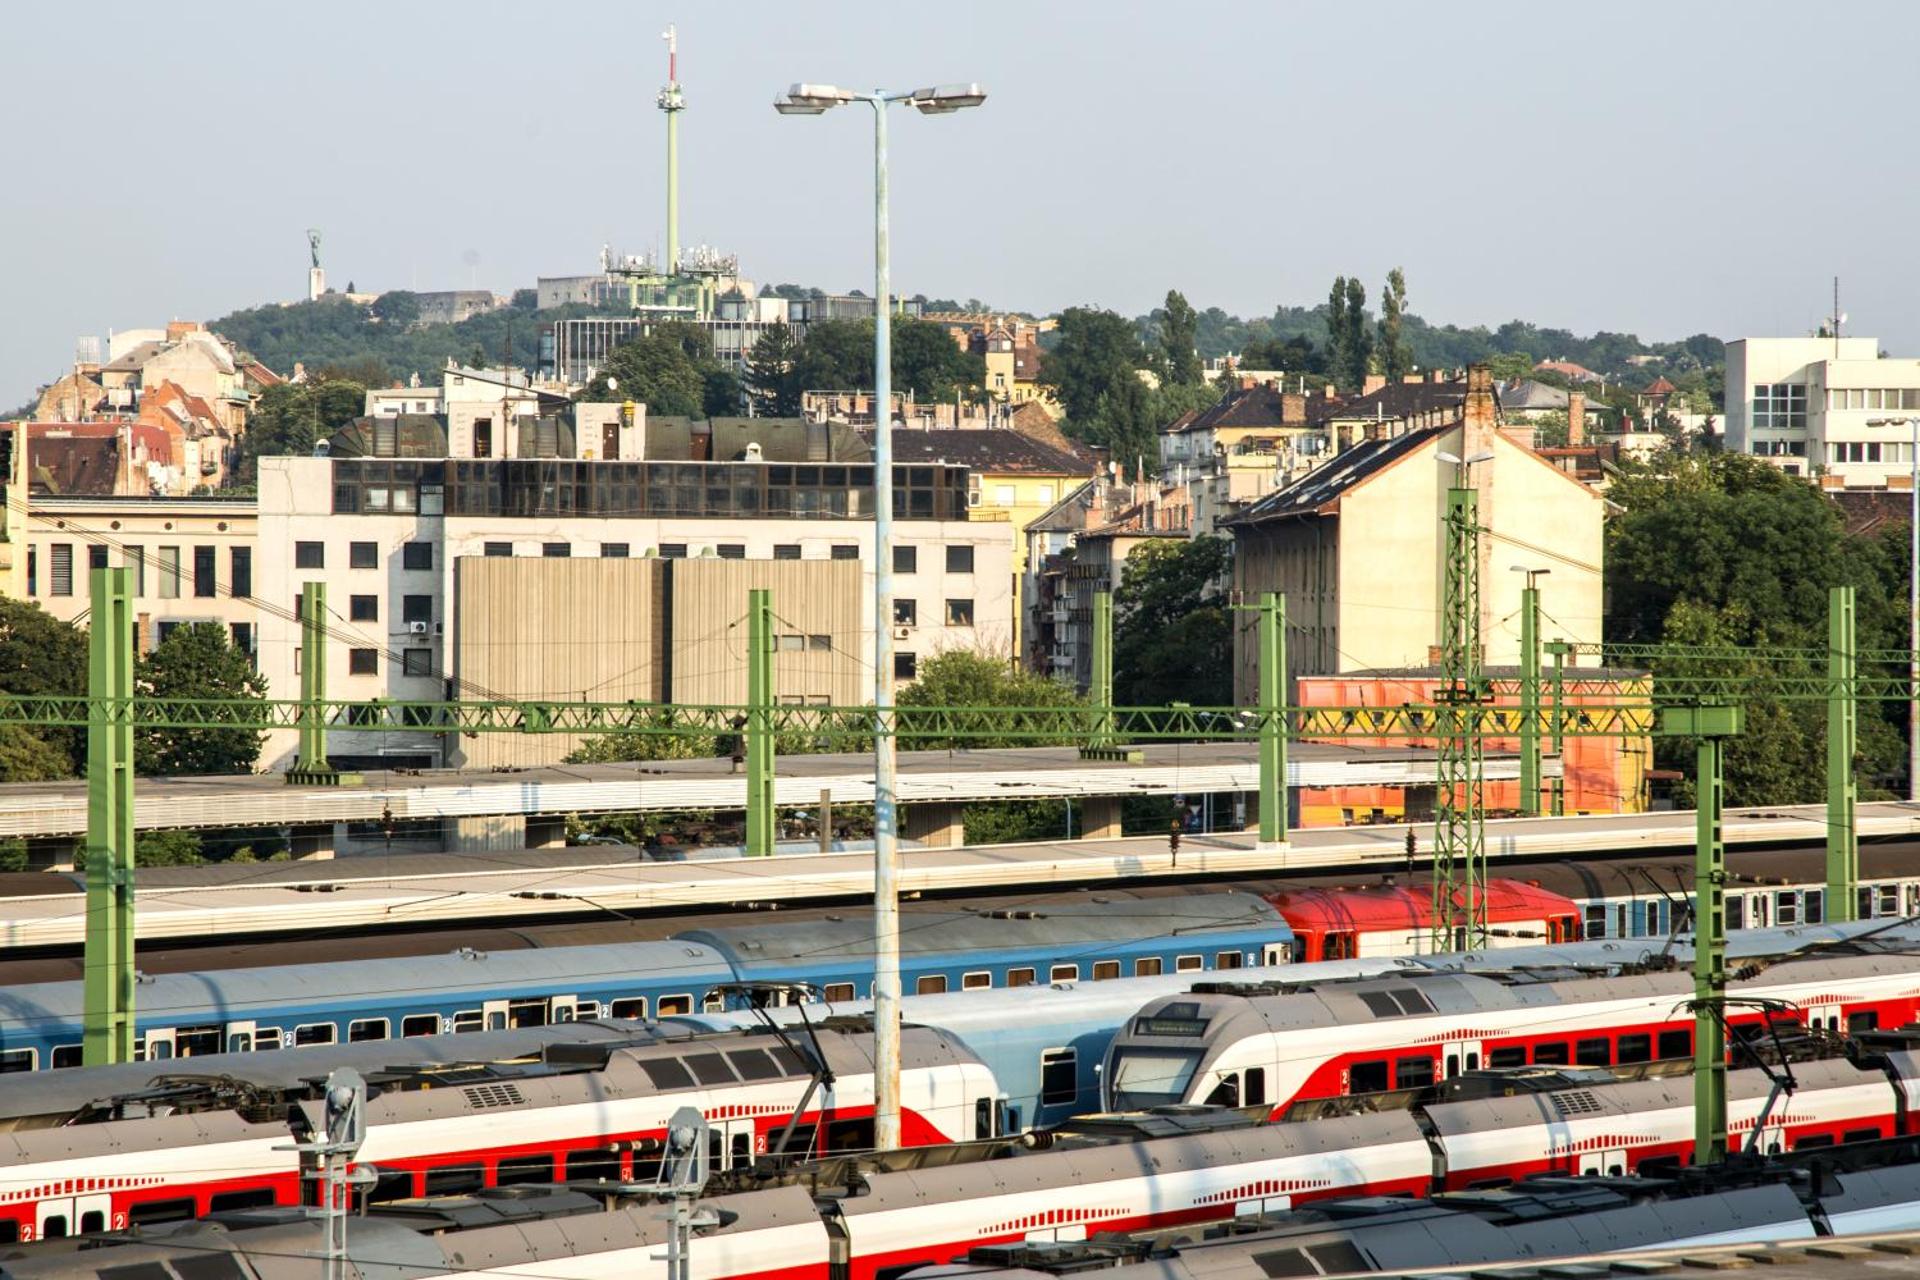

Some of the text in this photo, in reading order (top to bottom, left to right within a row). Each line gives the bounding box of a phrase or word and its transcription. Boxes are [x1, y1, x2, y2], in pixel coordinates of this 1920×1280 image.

[602, 1005, 609, 1018] 2
[444, 1019, 451, 1032] 2
[285, 1033, 292, 1046] 2
[1435, 1061, 1441, 1073] 2
[1484, 1056, 1489, 1068] 2
[1342, 1070, 1348, 1084] 2
[758, 1137, 765, 1151] 2
[116, 1214, 124, 1230] 2
[23, 1226, 32, 1242] 2
